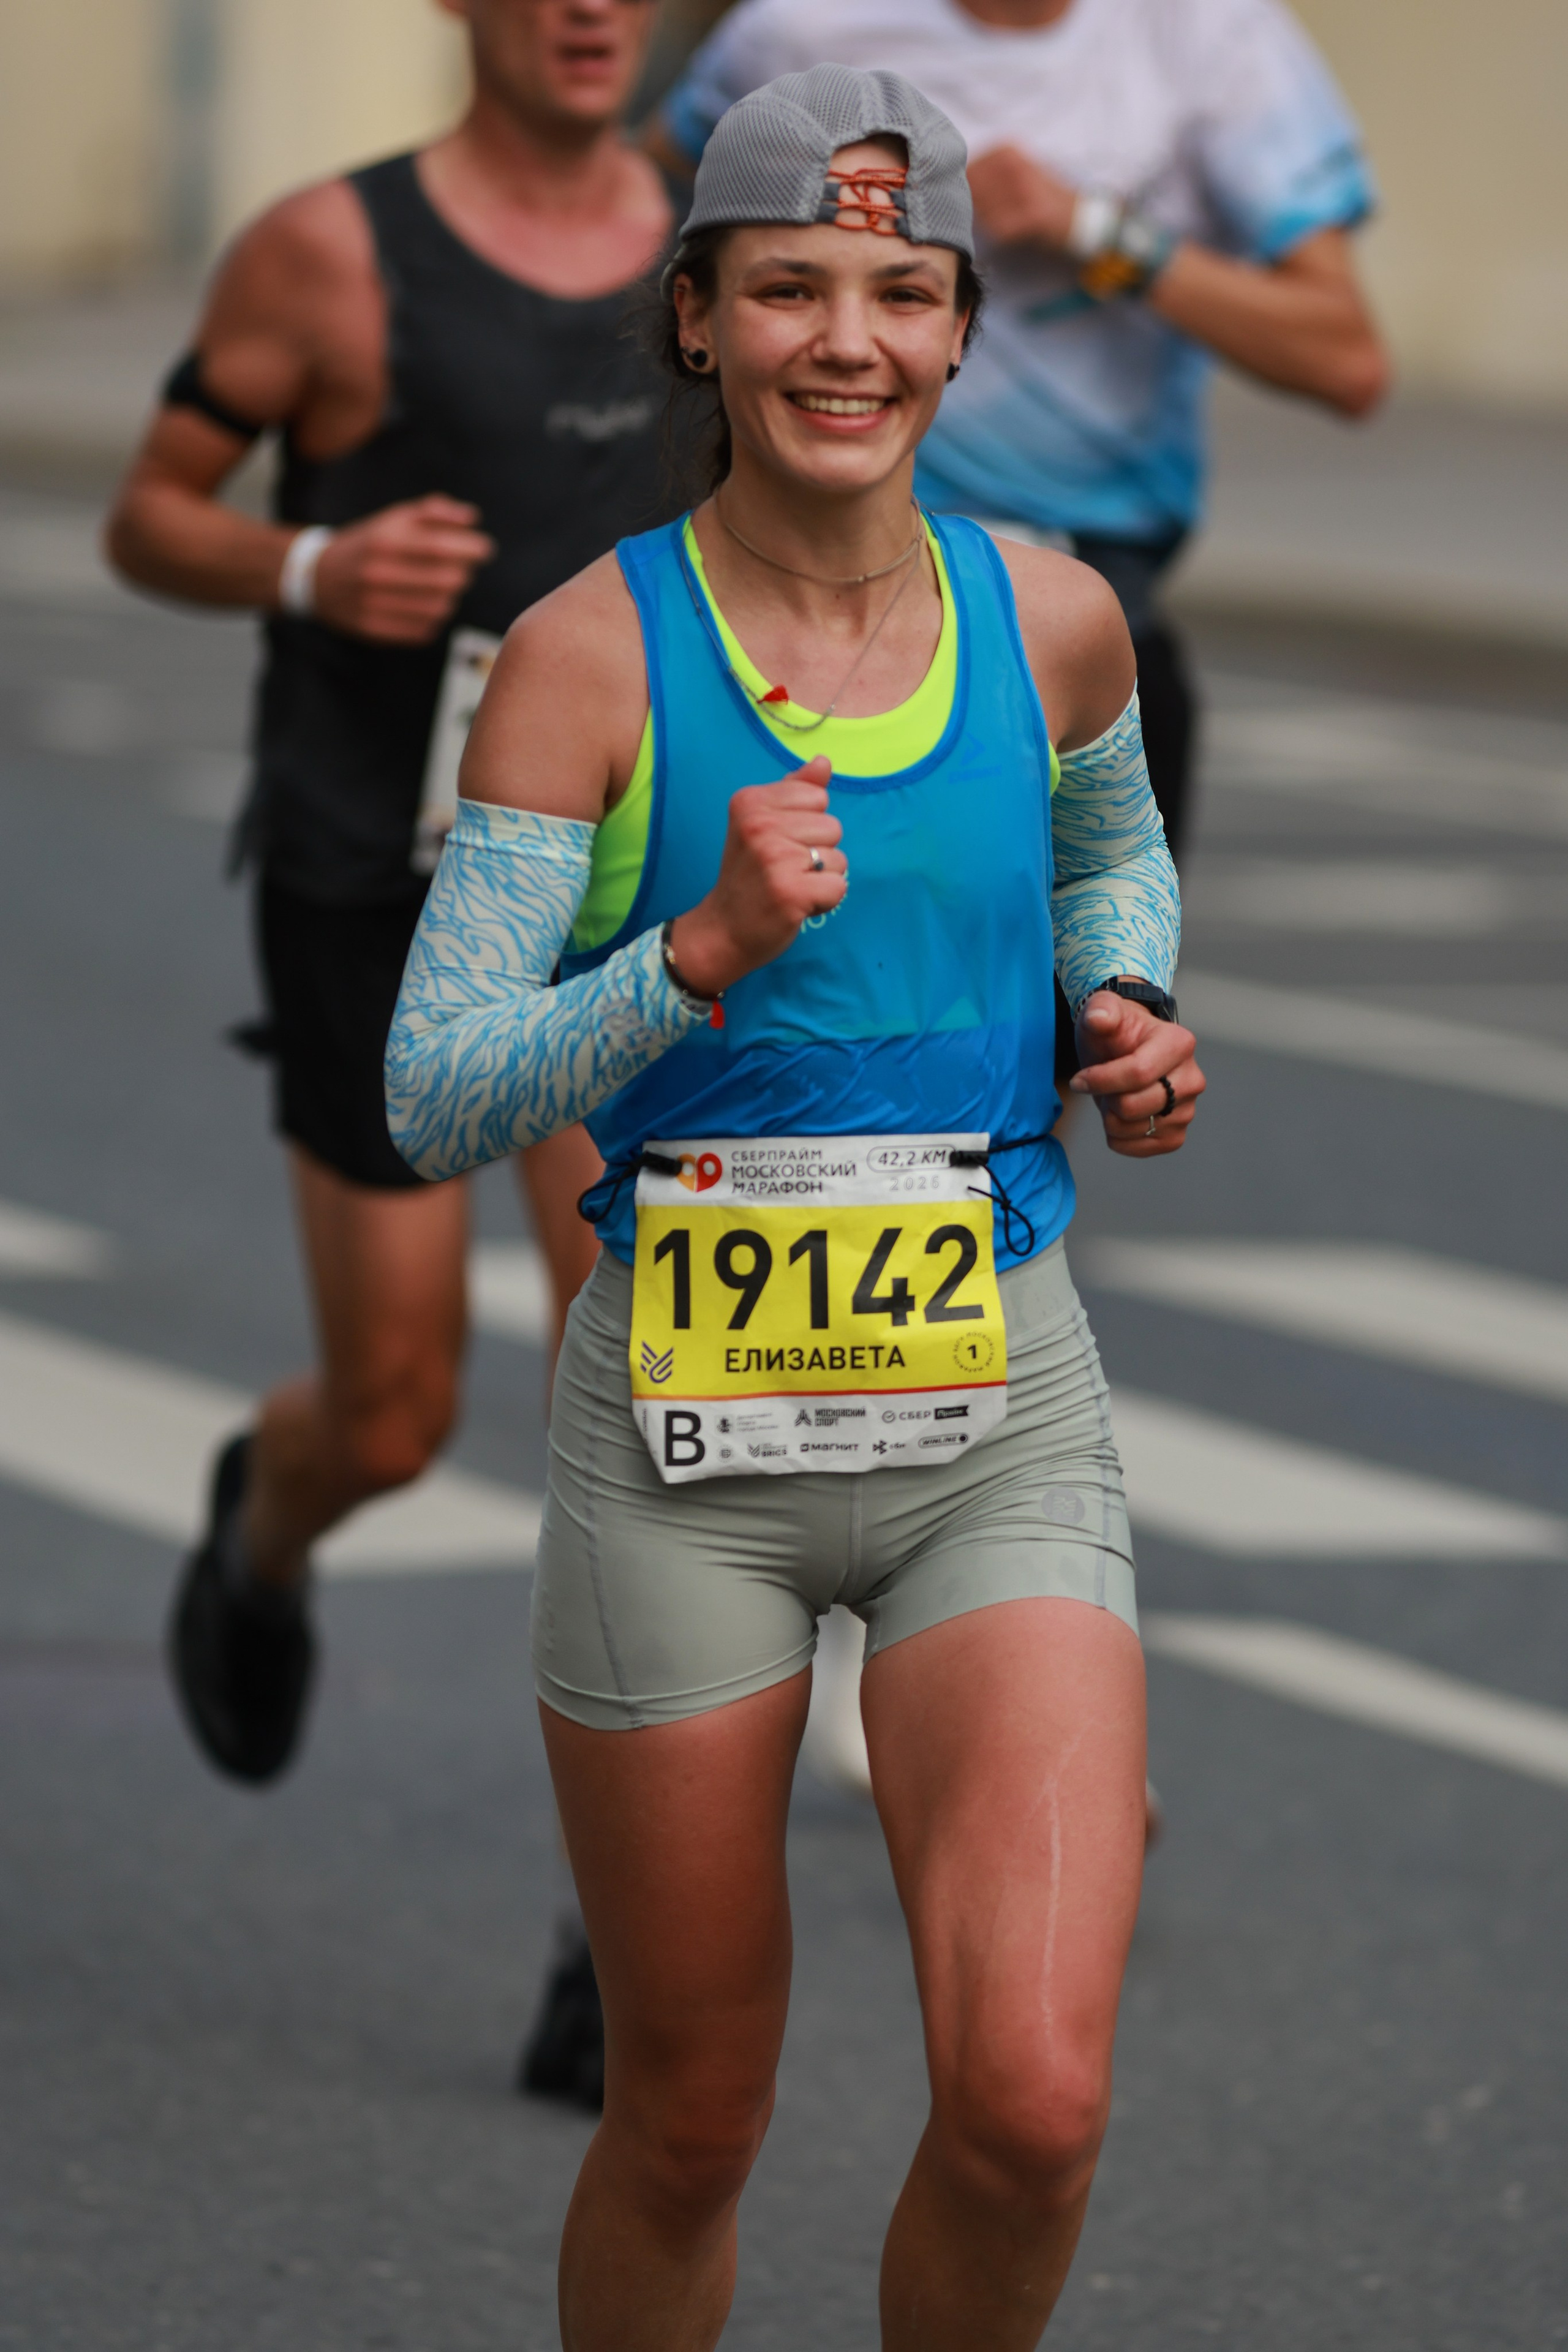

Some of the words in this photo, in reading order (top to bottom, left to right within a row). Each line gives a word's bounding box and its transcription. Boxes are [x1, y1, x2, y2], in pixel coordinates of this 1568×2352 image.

[731, 1147, 822, 1161] СБЕРПРАЙМ
[878, 1151, 915, 1167] 42,2
[732, 1161, 856, 1178] МОСКОВСКИЙ
[732, 1181, 822, 1193] МАРАФОН
[891, 1176, 940, 1191] 2026
[654, 1224, 984, 1330] 19142
[726, 1346, 905, 1372] ЕЛИЗАВЕТА
[967, 1344, 976, 1359] 1
[899, 1411, 931, 1420] СБЕР
